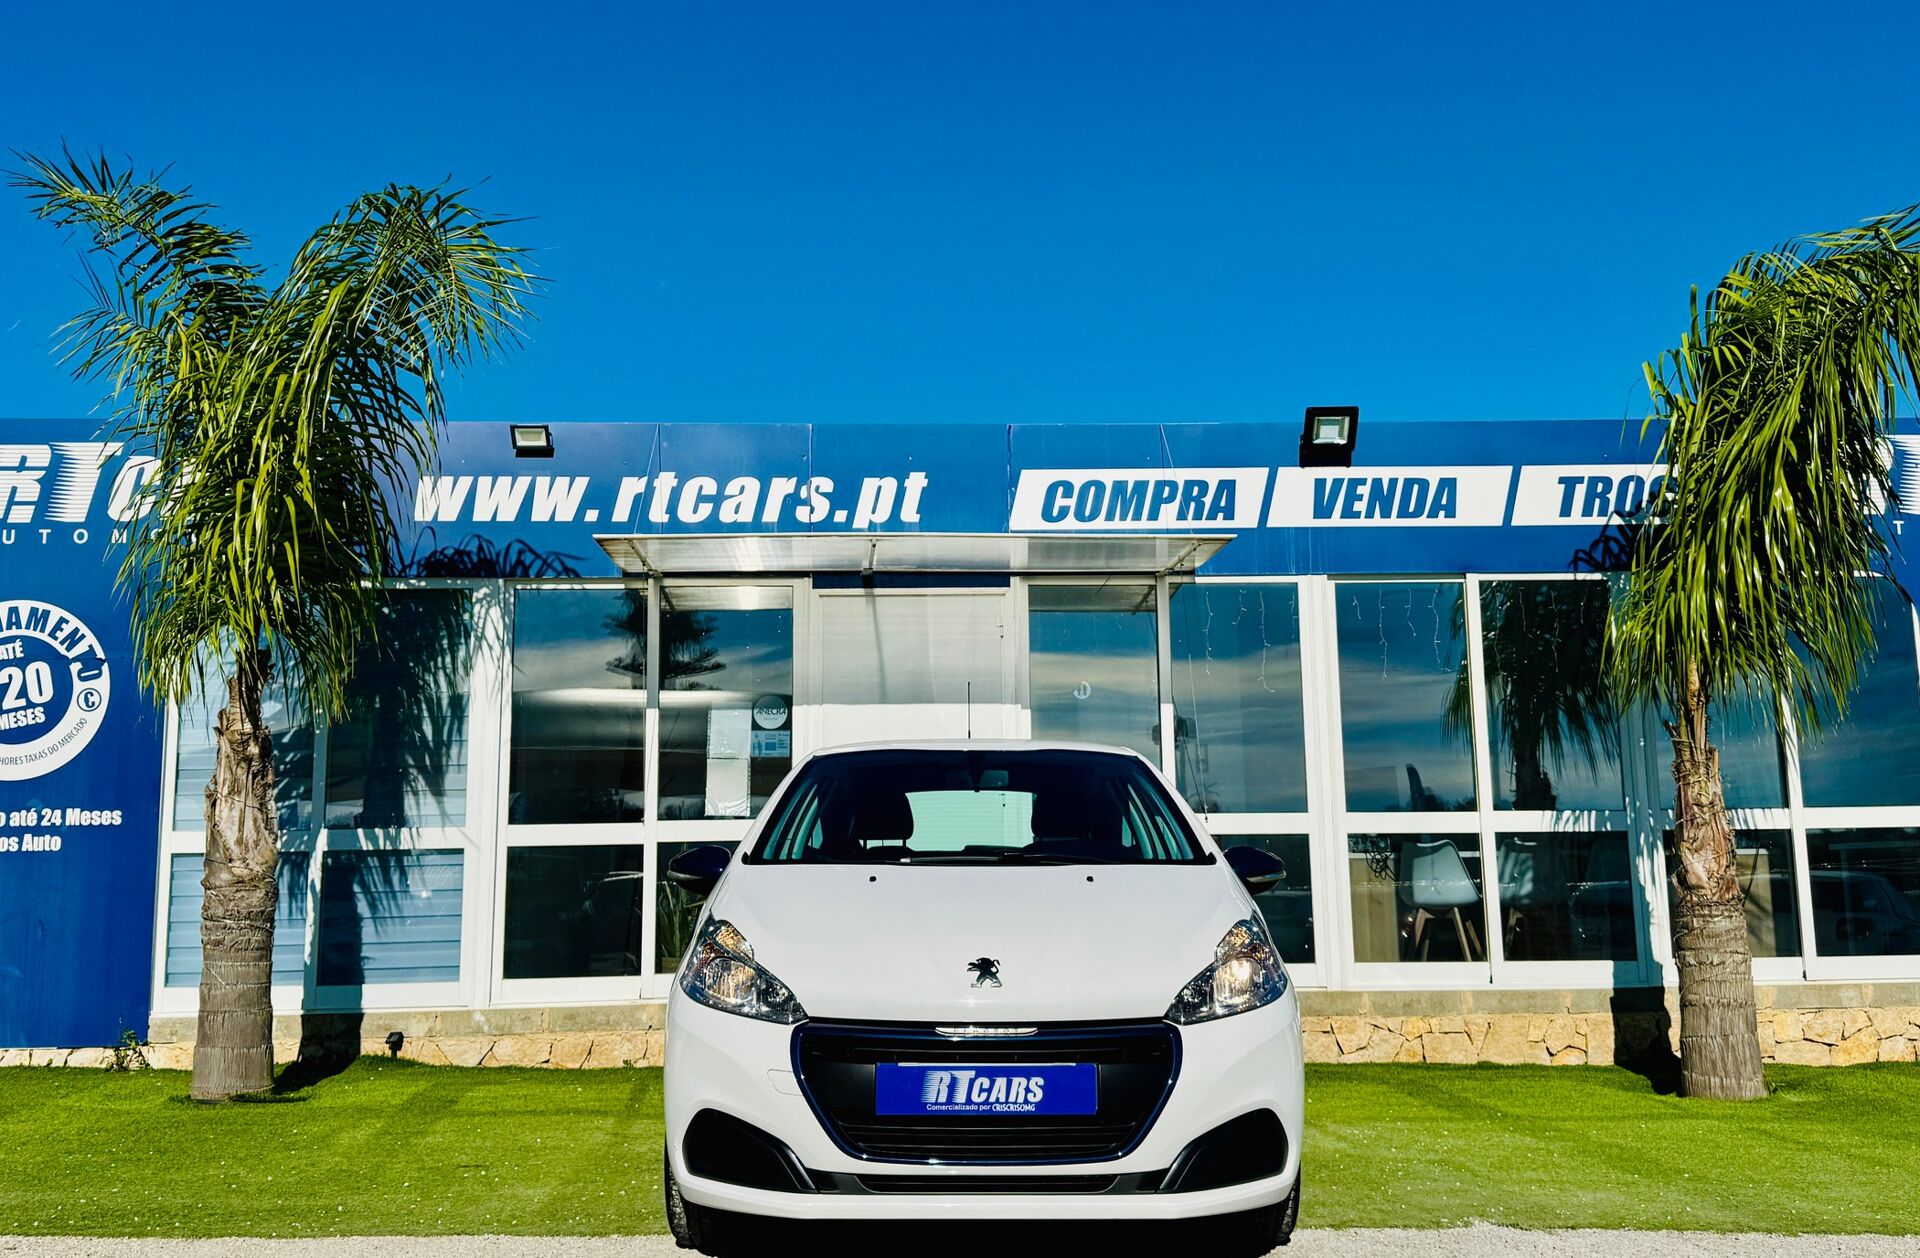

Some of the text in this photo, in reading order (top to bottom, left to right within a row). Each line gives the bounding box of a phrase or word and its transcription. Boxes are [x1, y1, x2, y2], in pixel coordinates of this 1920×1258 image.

[1040, 479, 1237, 523] COMPRA
[1312, 477, 1457, 519] VENDA
[1557, 474, 1679, 518] TROC
[0, 706, 46, 731] MESES
[24, 749, 48, 764] TAXAS
[47, 743, 59, 755] DO
[57, 717, 88, 748] MERCADO
[9, 807, 38, 828] até
[40, 807, 62, 827] 24
[65, 807, 122, 827] Meses
[21, 833, 62, 852] Auto
[926, 1103, 978, 1111] Comercializado
[979, 1104, 991, 1112] por
